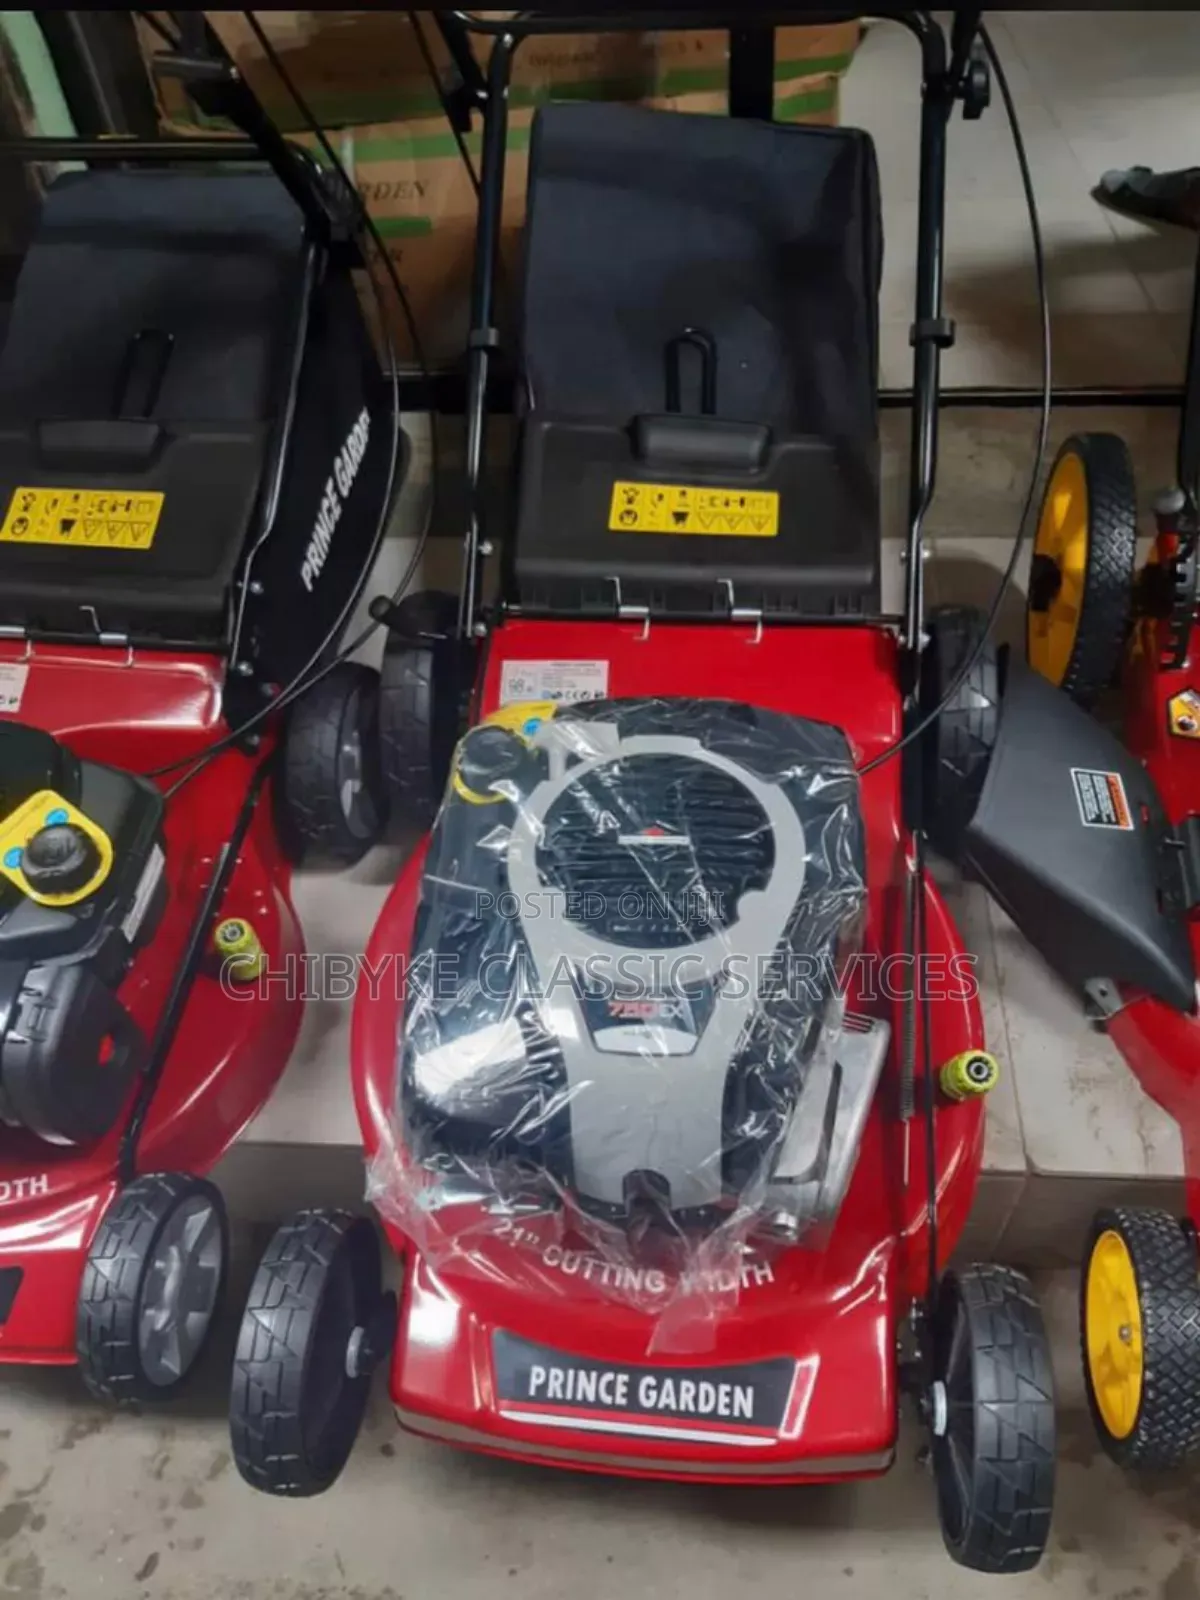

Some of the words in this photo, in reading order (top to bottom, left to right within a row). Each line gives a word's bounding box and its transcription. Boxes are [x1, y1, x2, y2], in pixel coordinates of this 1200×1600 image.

[300, 476, 342, 592] PRINCE
[542, 1243, 667, 1294] CUTTING
[679, 1260, 775, 1296] WIDTH
[528, 1365, 630, 1406] PRINCE
[638, 1374, 755, 1419] GARDEN
